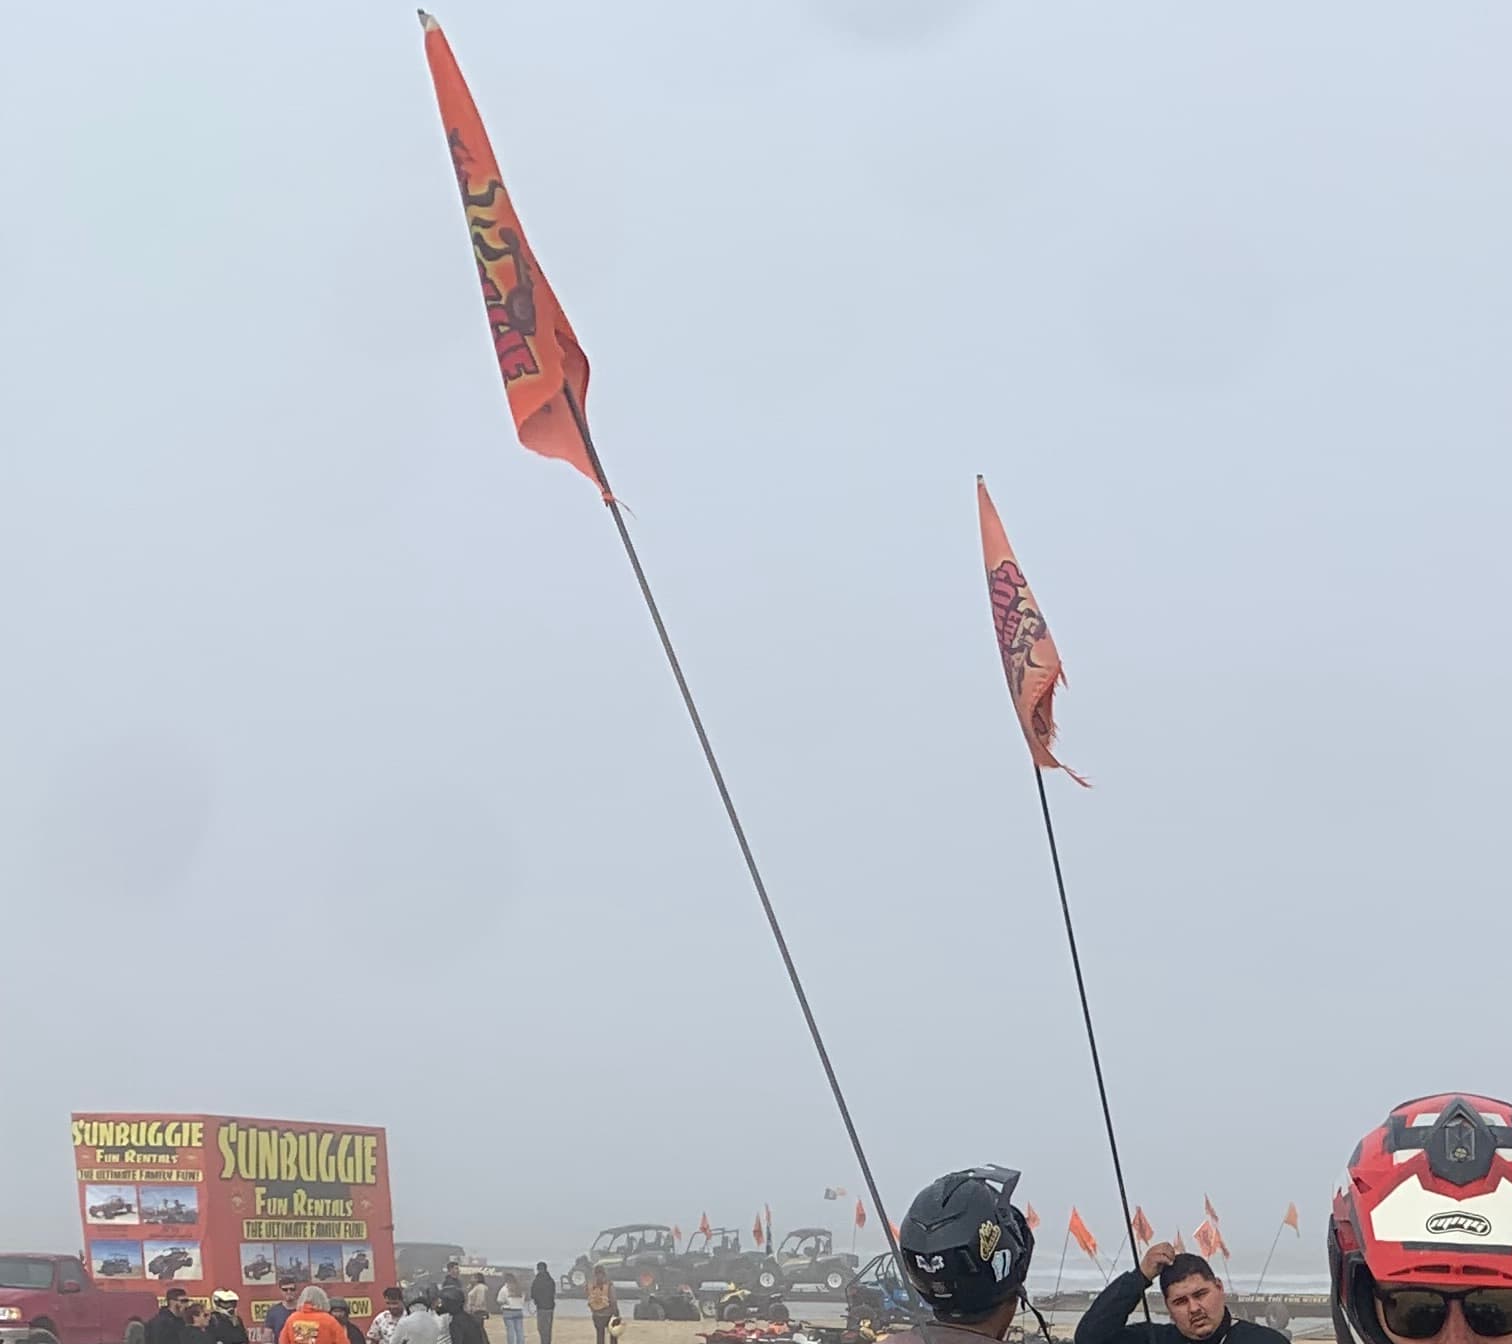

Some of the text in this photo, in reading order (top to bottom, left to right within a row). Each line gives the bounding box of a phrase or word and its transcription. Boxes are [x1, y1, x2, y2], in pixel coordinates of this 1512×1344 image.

[72, 1119, 204, 1147] SUNBUGGIE
[217, 1122, 378, 1185] SUNBUGGIE
[254, 1186, 354, 1217] FUN RENTALS
[245, 1221, 263, 1238] THE
[264, 1221, 309, 1238] ULTIMATE
[310, 1222, 341, 1239] FAMILY
